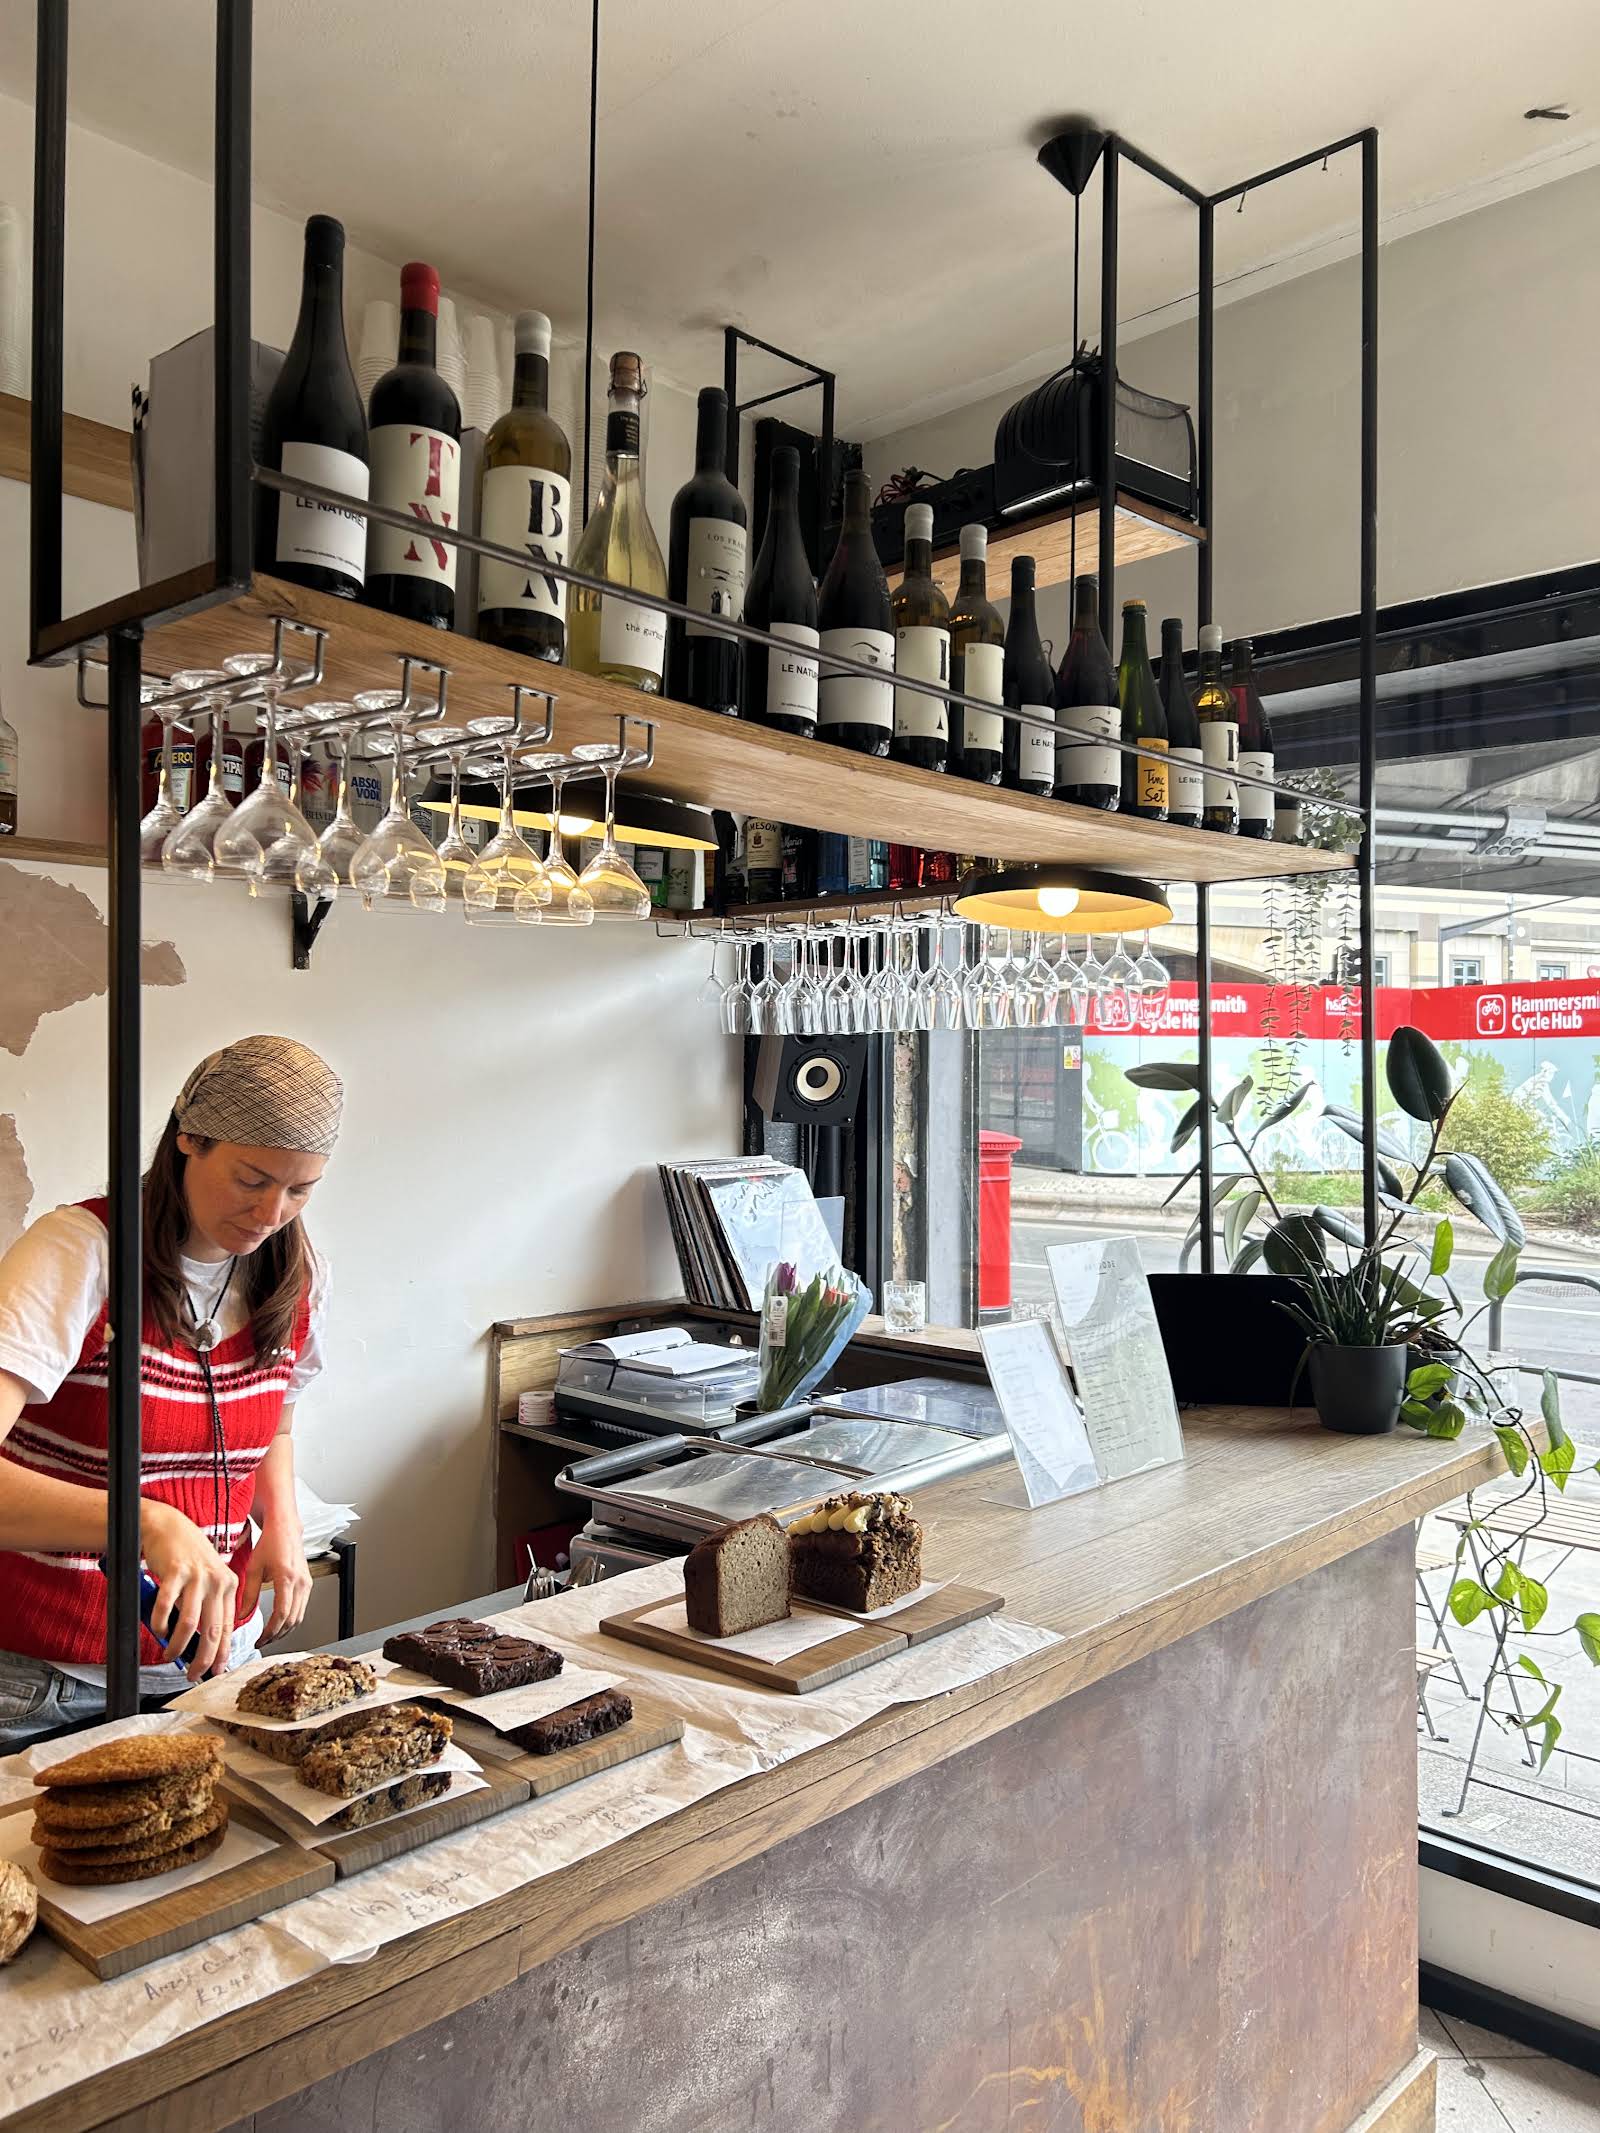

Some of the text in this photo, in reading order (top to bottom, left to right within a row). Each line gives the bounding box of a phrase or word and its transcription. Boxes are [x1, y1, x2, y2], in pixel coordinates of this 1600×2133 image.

[295, 497, 314, 509] LE
[625, 623, 641, 633] the
[781, 663, 794, 673] LE
[1031, 738, 1042, 747] LE
[1178, 776, 1188, 784] LE
[1511, 1010, 1583, 1036] Cycle Hub
